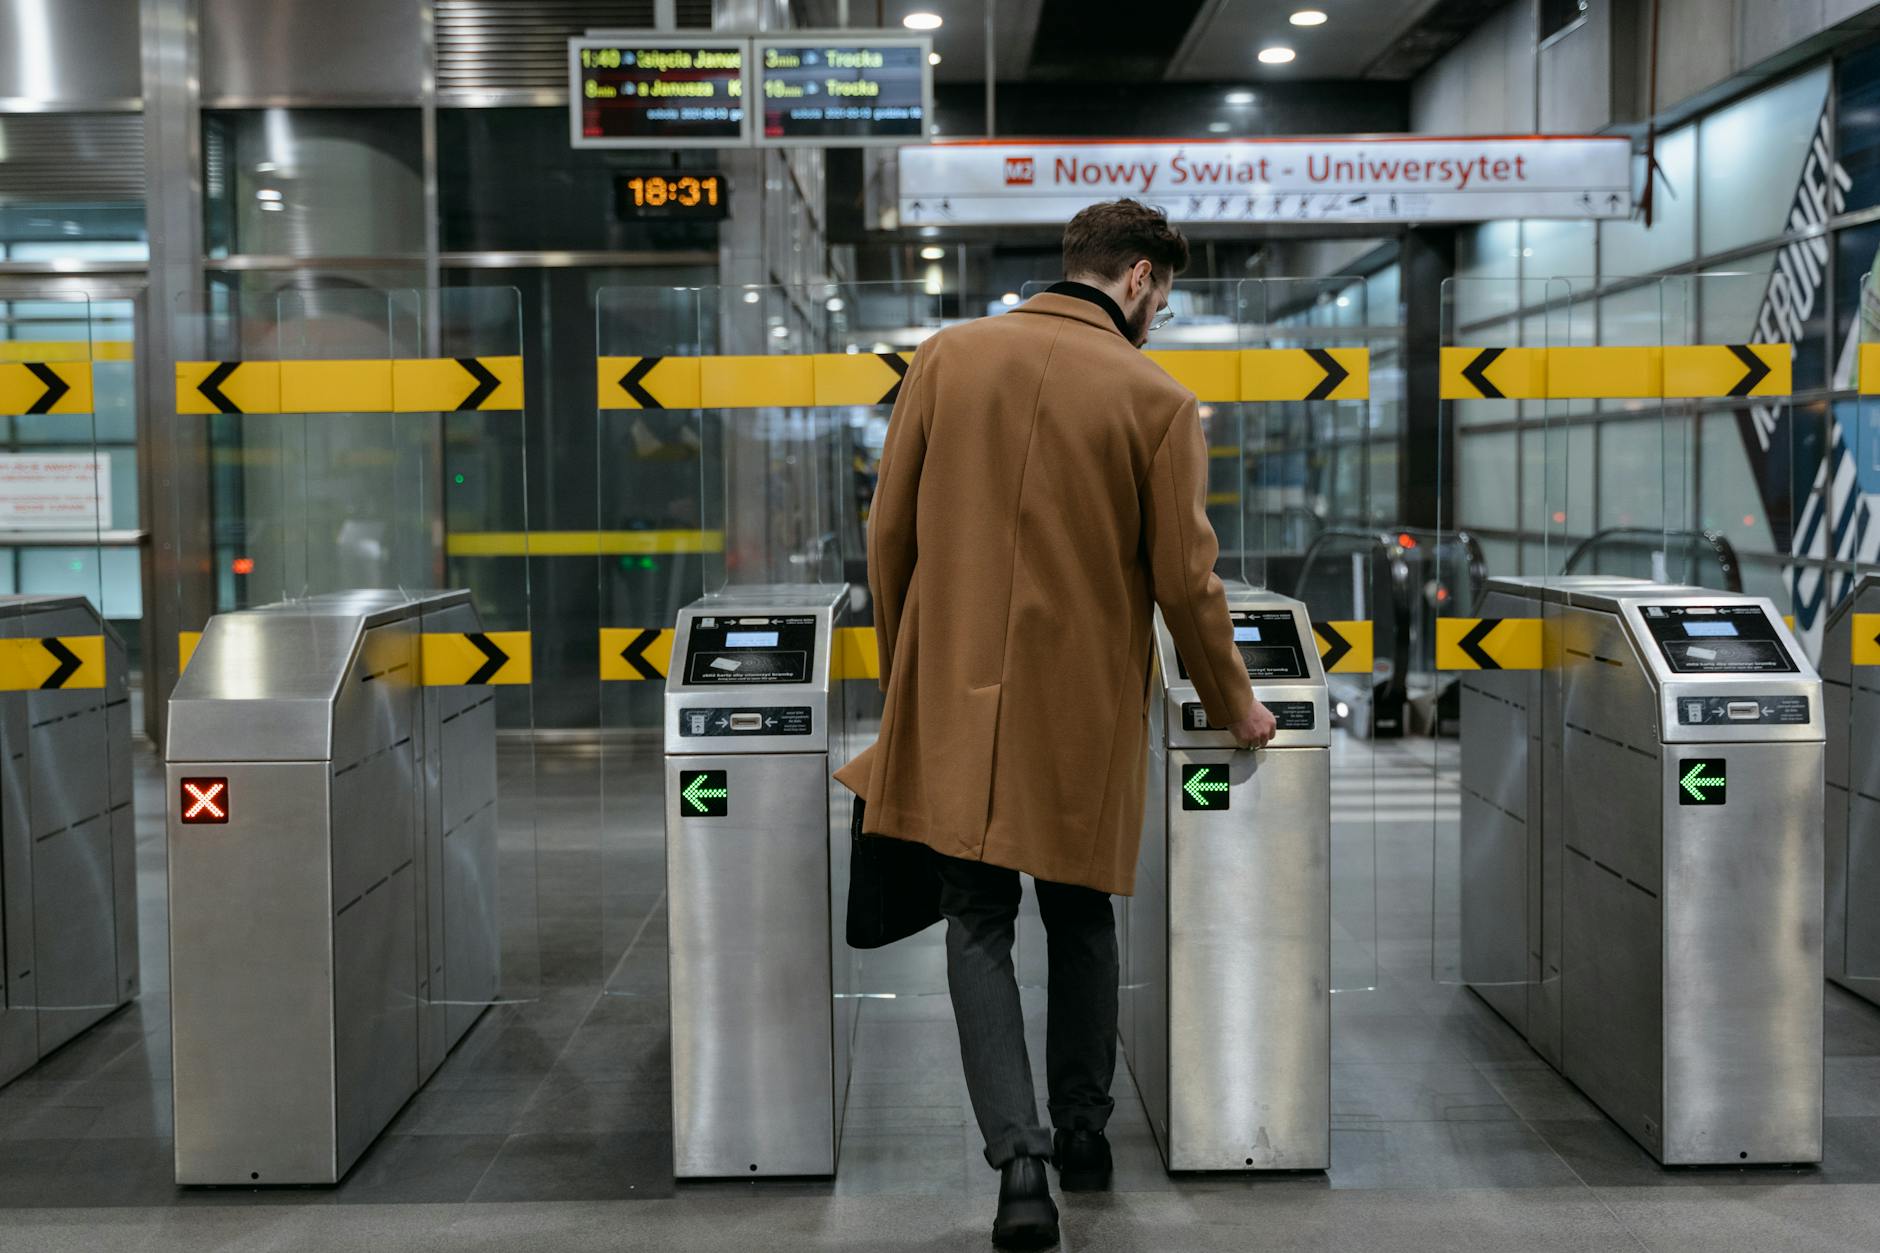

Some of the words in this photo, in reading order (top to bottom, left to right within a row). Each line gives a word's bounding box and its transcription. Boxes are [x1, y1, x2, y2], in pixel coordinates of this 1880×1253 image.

[582, 49, 620, 68] 1:40
[825, 50, 883, 68] Trocka
[650, 79, 714, 97] Janusza
[825, 79, 879, 97] Trocka
[1055, 158, 1158, 192] Nowy
[1171, 149, 1269, 184] Świat
[1307, 153, 1527, 189] Uniwersytet
[628, 177, 718, 206] 18:31
